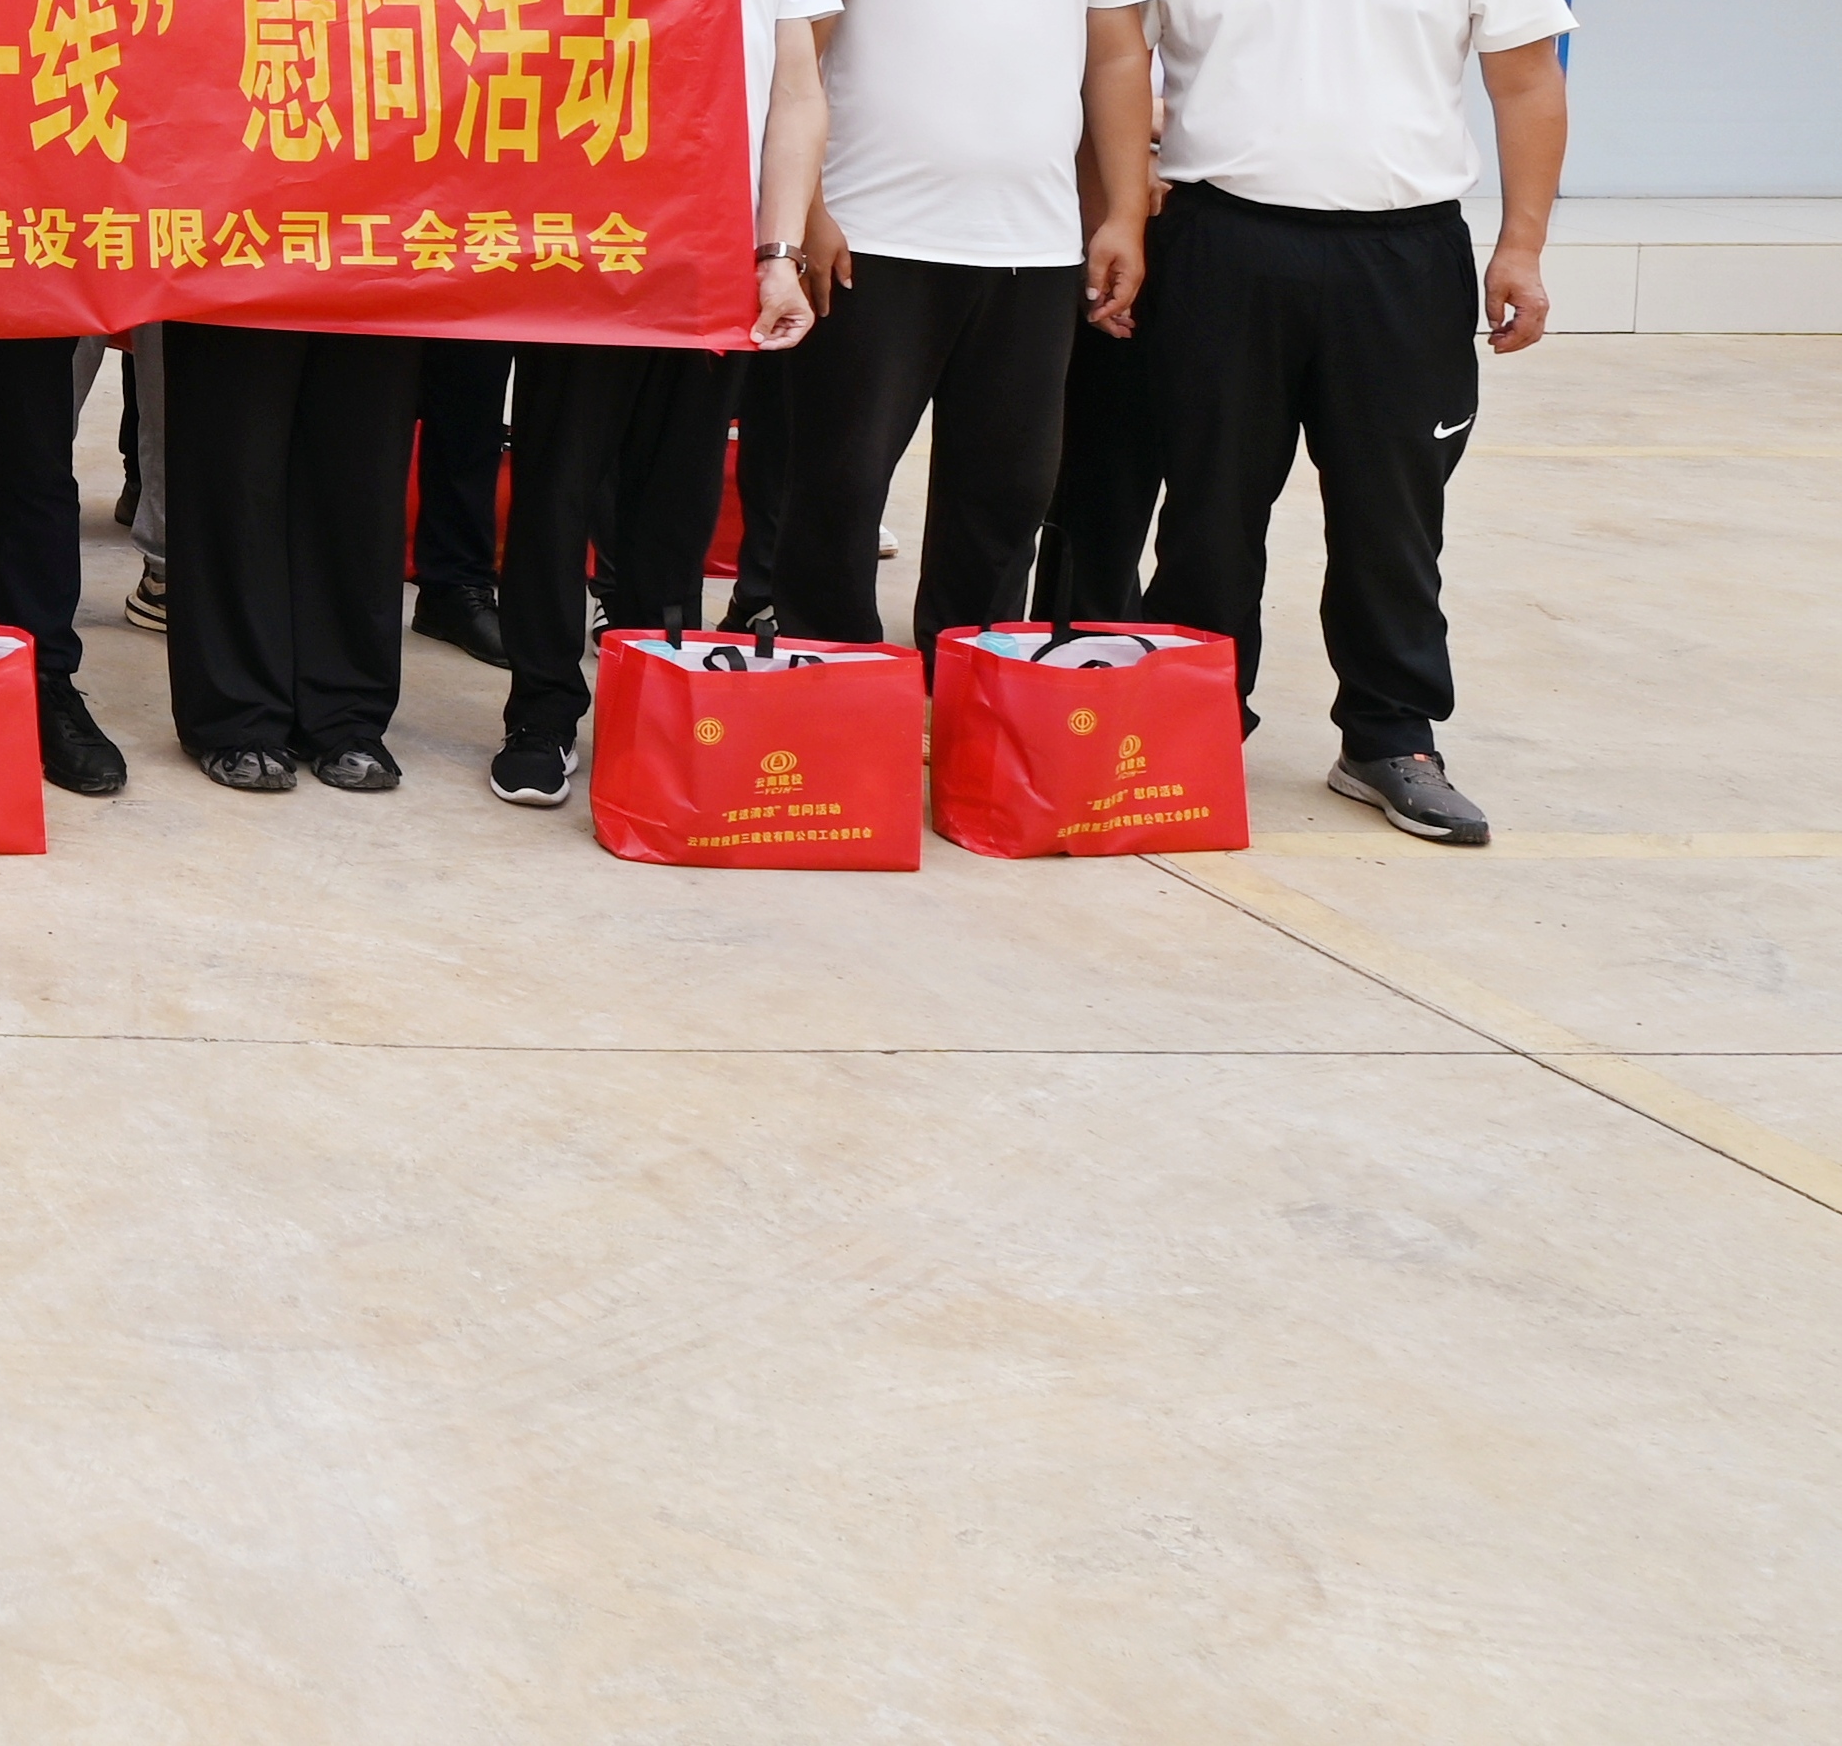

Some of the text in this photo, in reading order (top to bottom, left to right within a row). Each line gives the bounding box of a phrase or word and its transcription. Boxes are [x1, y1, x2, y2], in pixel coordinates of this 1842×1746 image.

[755, 773, 803, 788] 云南建投
[1134, 783, 1184, 800] 慰问活动
[788, 803, 841, 817] 慰问活动
[687, 827, 872, 847] 云南建投第三建设有限公司工会委员会
